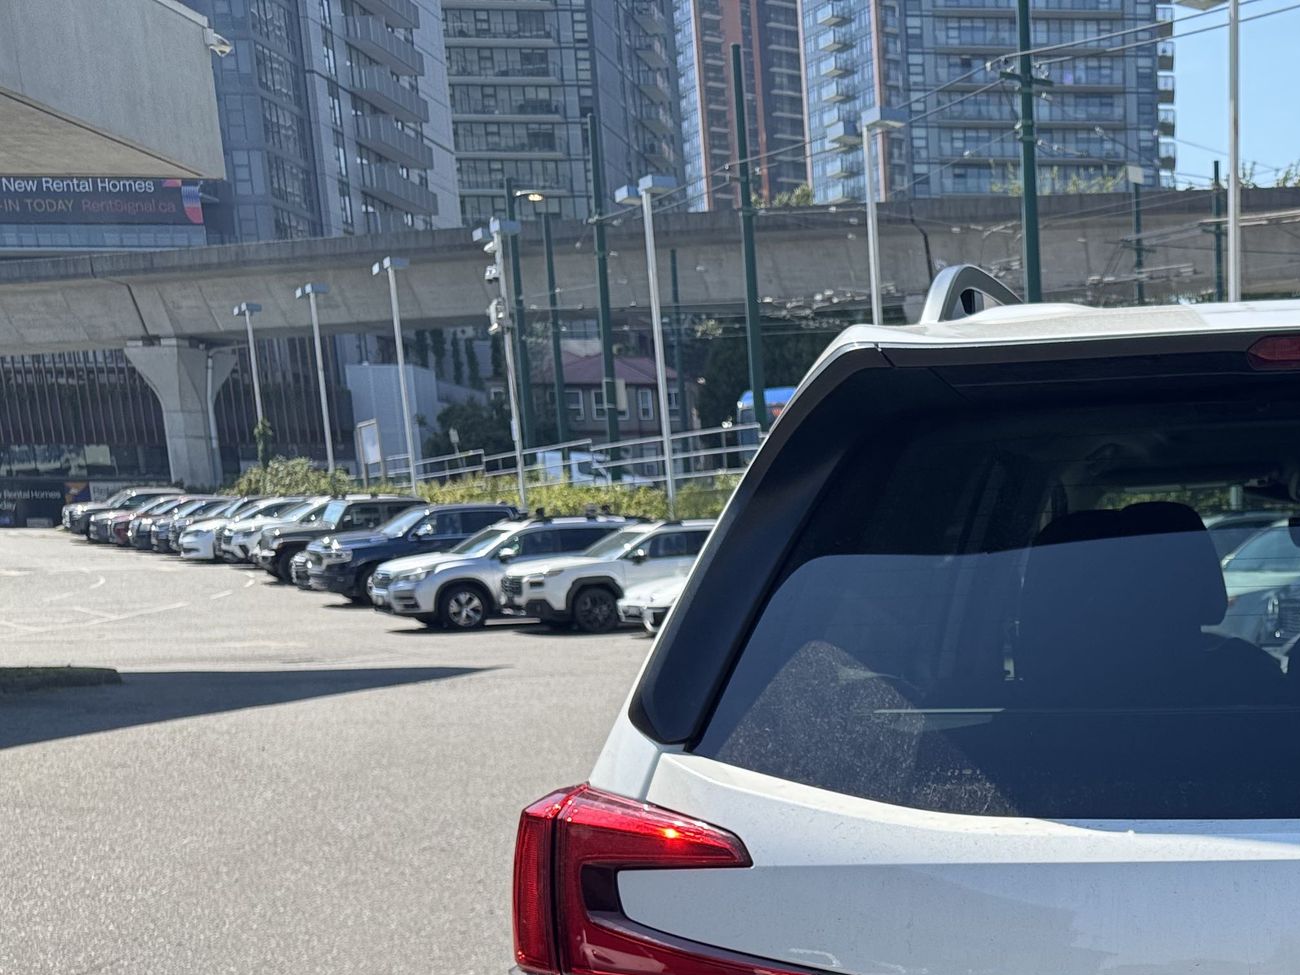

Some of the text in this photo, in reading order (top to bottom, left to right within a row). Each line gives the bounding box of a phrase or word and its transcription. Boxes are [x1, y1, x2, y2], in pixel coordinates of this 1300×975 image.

[2, 177, 154, 192] New Rental Homes
[25, 199, 73, 212] TODAY
